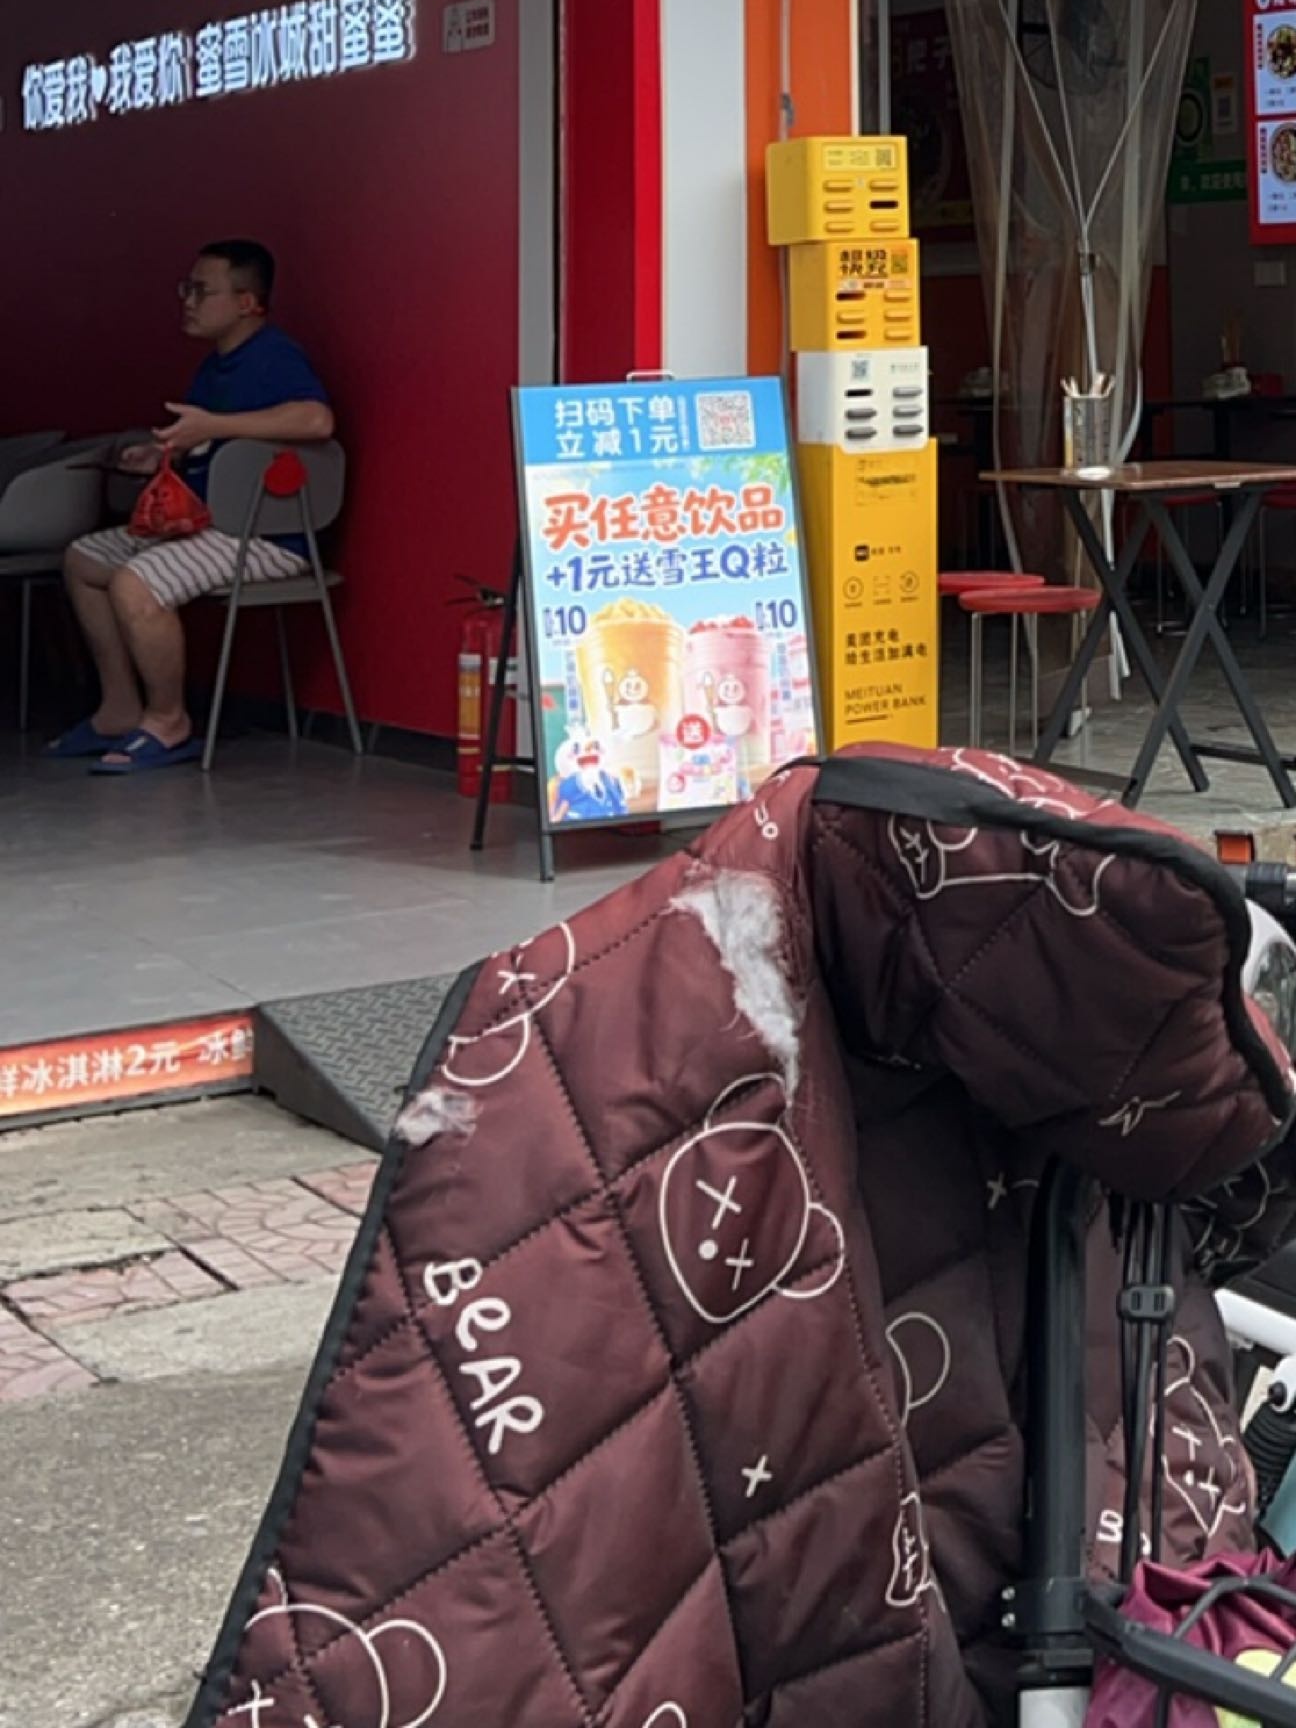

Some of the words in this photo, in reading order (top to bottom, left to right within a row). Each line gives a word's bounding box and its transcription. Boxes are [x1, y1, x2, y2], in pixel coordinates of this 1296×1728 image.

[554, 395, 676, 428] 扫码下单
[555, 425, 679, 459] 立减1元
[543, 485, 785, 550] 买任意饮品
[546, 542, 788, 592] +1元送雪王Q粒
[554, 604, 586, 635] 10
[766, 598, 798, 628] 10
